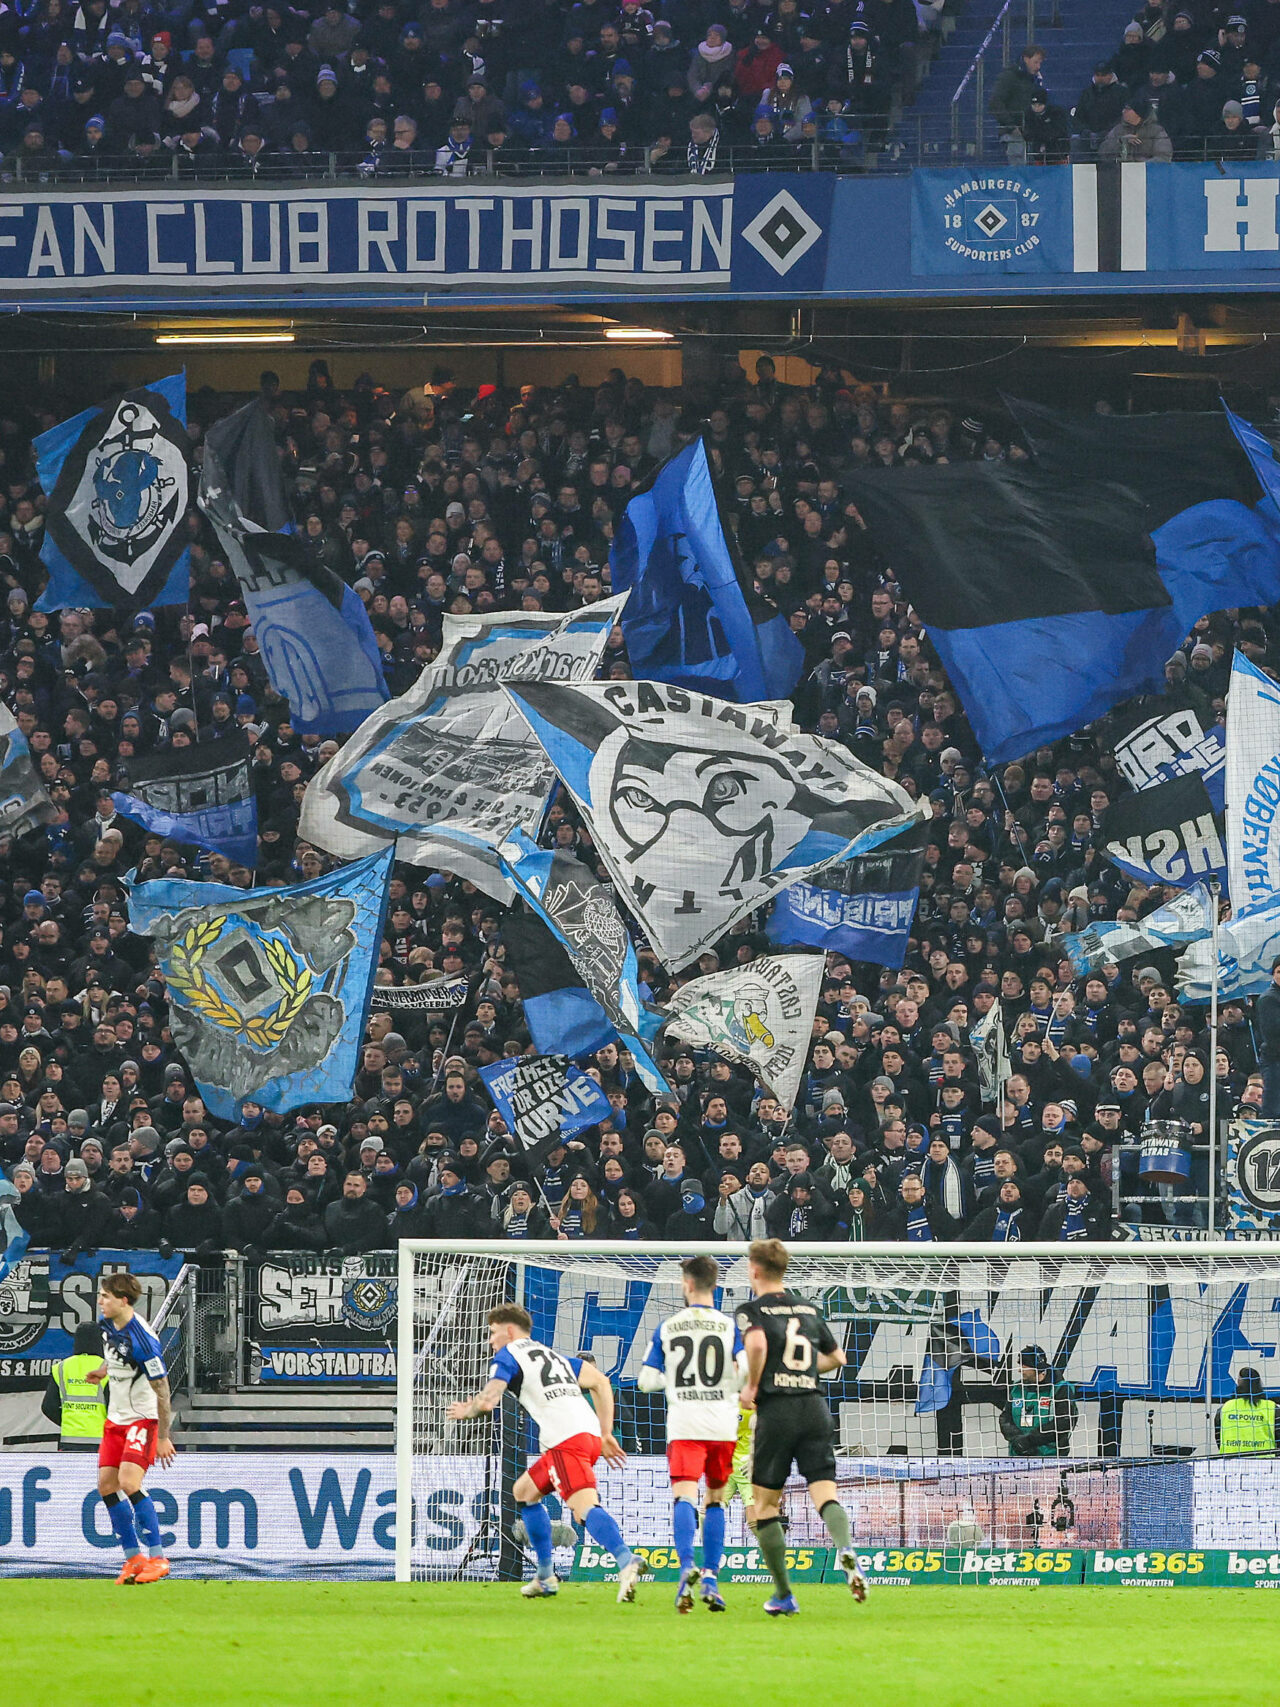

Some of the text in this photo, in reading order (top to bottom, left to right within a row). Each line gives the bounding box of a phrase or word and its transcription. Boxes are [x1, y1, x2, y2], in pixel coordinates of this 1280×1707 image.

[944, 179, 1040, 206] HAMBURGER SV
[944, 214, 962, 228] 18
[1021, 213, 1040, 227] 87
[147, 201, 329, 274] CLUB
[358, 198, 733, 273] ROTHOSEN
[945, 235, 1040, 262] SUPPORTERS CLUB
[1114, 709, 1206, 793] ORD
[533, 1071, 570, 1100] DIE
[513, 1077, 601, 1151] KURVE
[1139, 1226, 1226, 1243] SEKTION
[782, 1317, 812, 1372] 6
[670, 1335, 725, 1388] 20
[1240, 1413, 1265, 1422] POWER
[126, 1425, 148, 1446] 44
[963, 1549, 1073, 1574] bet365
[1093, 1550, 1206, 1575] bet365
[988, 1576, 1041, 1587] SPORTWETTEN
[1120, 1577, 1174, 1588] SPORTWETTEN
